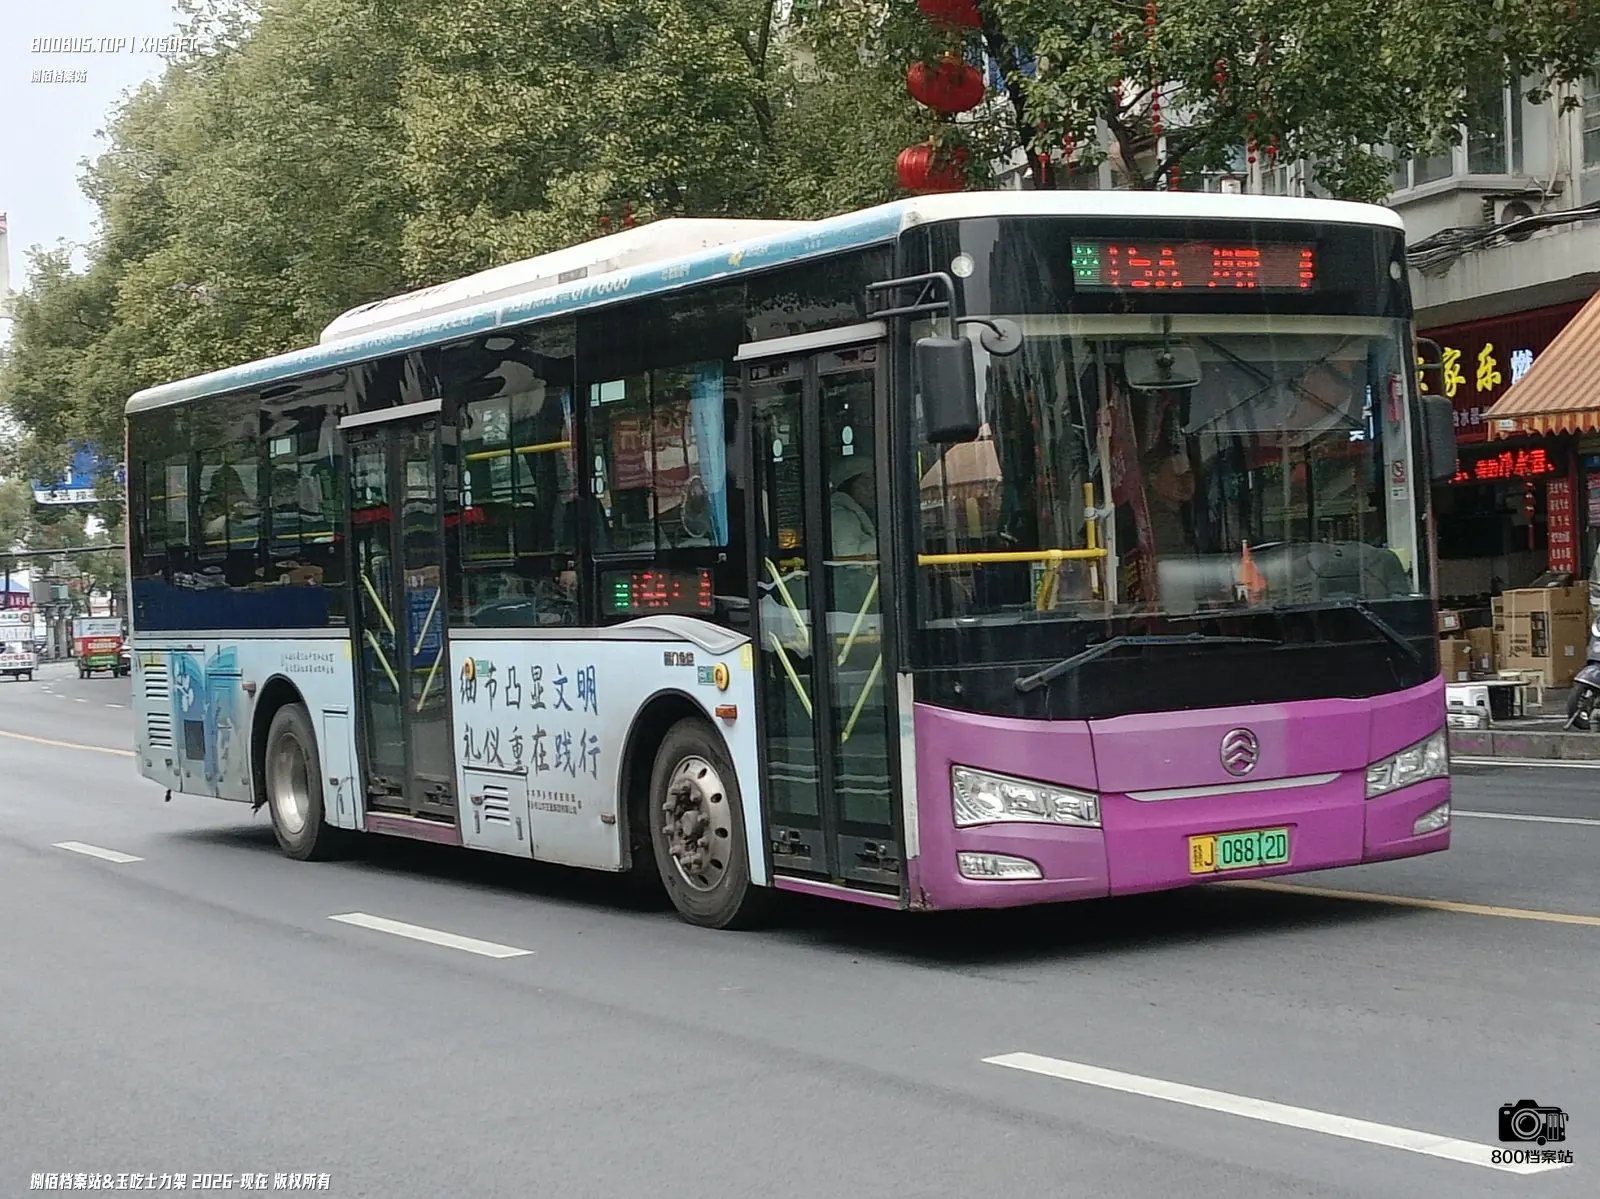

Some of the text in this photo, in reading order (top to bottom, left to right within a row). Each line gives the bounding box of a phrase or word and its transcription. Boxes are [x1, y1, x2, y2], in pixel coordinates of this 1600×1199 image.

[460, 664, 599, 717] 细节凸显文明
[463, 723, 602, 779] 礼仪重在践行
